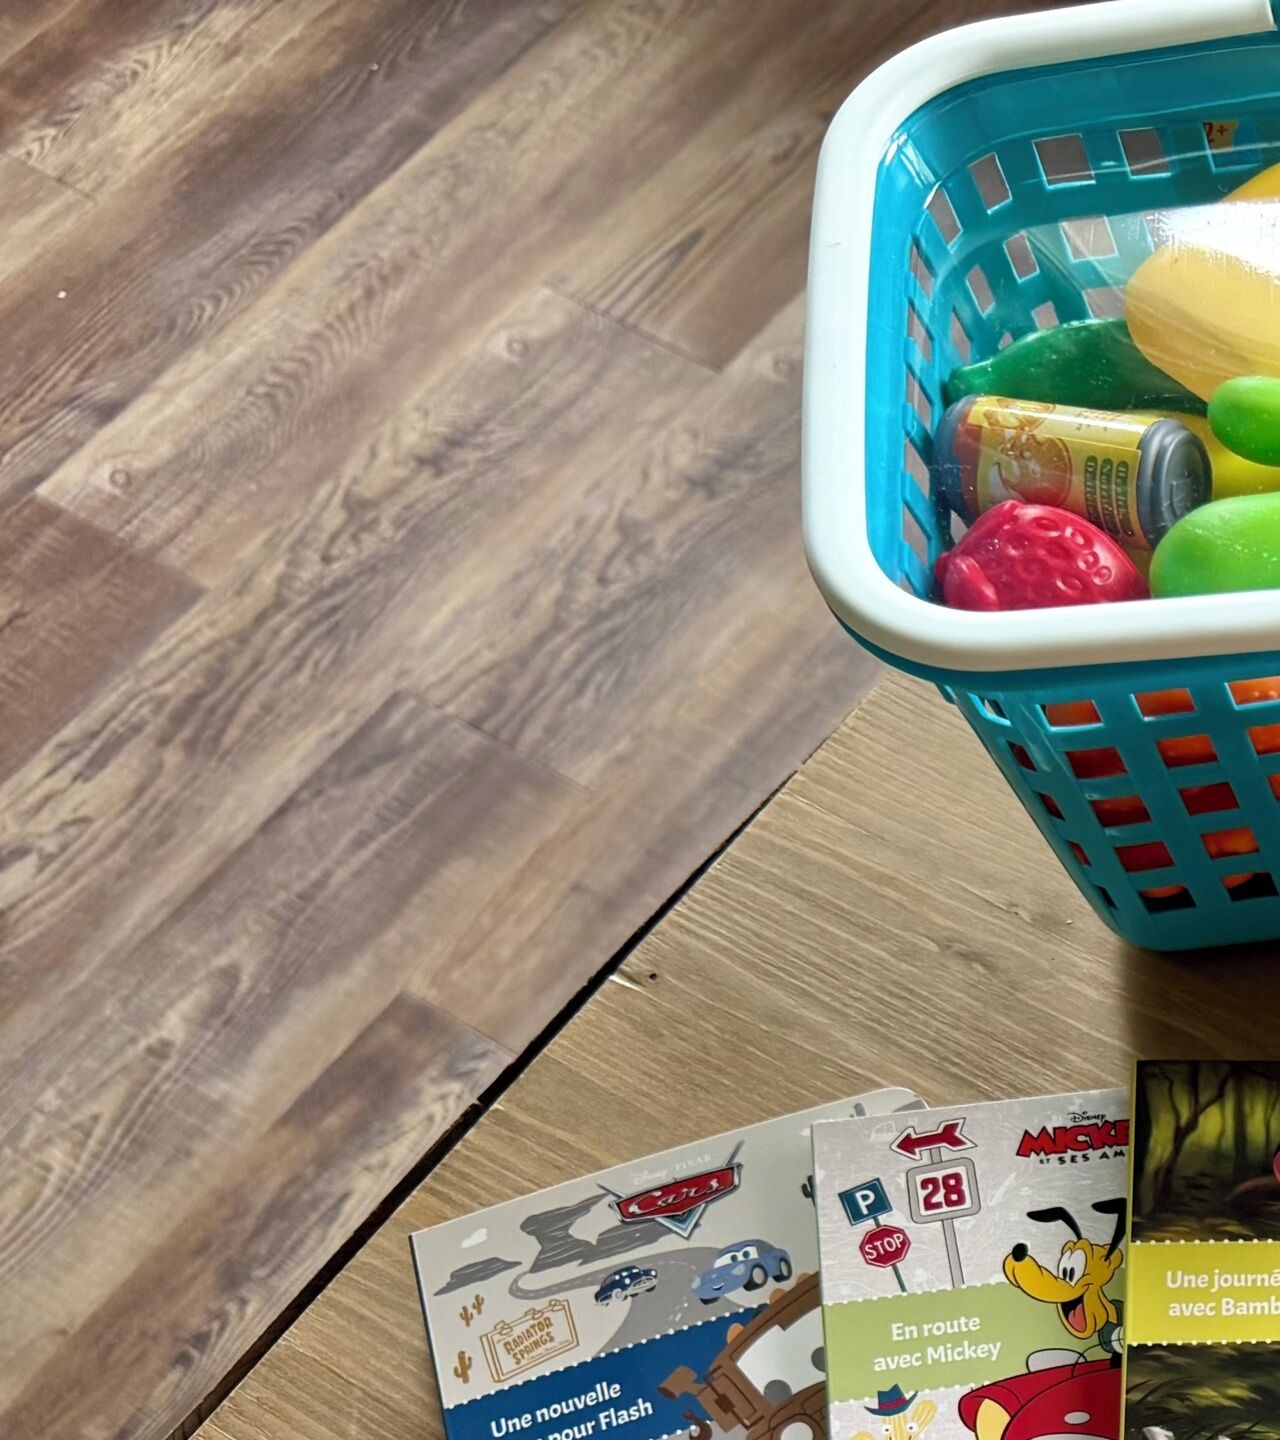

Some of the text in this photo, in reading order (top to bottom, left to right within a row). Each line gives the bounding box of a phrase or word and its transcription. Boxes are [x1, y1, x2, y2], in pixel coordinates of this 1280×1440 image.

[1057, 1153, 1090, 1165] SES
[855, 1190, 876, 1215] P
[920, 1172, 967, 1211] 28
[864, 1233, 904, 1260] STOP
[1166, 1271, 1209, 1289] Une
[1168, 1301, 1216, 1316] avec
[503, 1316, 554, 1356] RADIATOR
[891, 1316, 981, 1341] En route
[512, 1331, 555, 1366] SPRINGS
[873, 1340, 1002, 1372] avec Mickey
[491, 1381, 622, 1438] Une nouvelle
[599, 1398, 654, 1431] Flash
